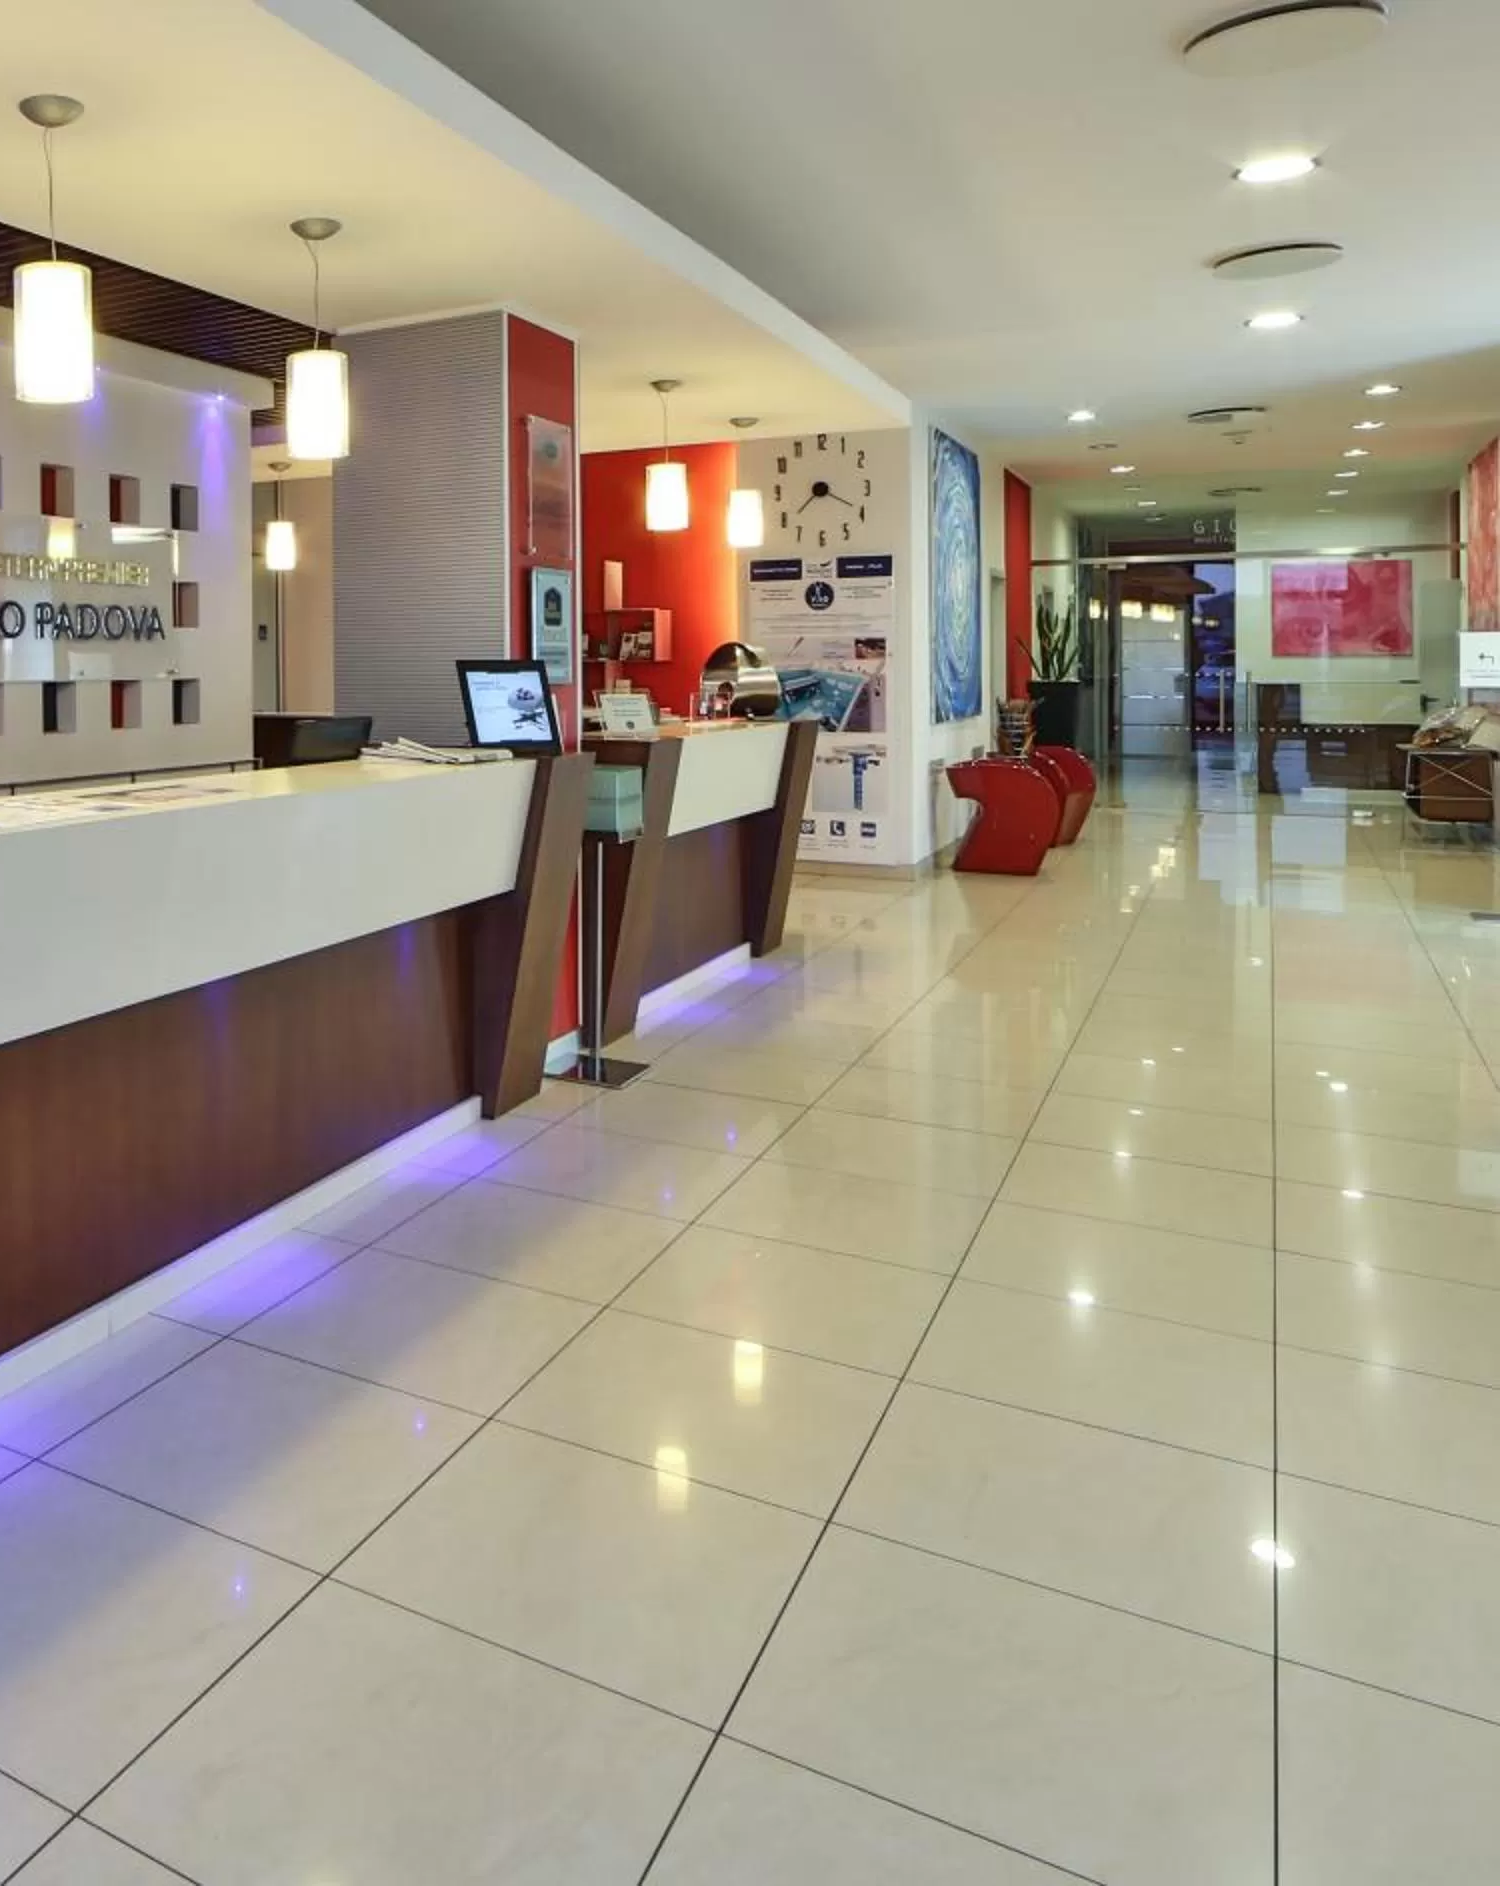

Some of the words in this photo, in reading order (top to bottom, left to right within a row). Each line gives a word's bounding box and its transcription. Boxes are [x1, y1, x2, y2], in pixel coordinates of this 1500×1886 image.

[857, 450, 865, 468] 2
[864, 480, 871, 497] 3
[795, 525, 803, 543] 7
[843, 522, 850, 541] 5
[35, 602, 165, 641] PADOVA
